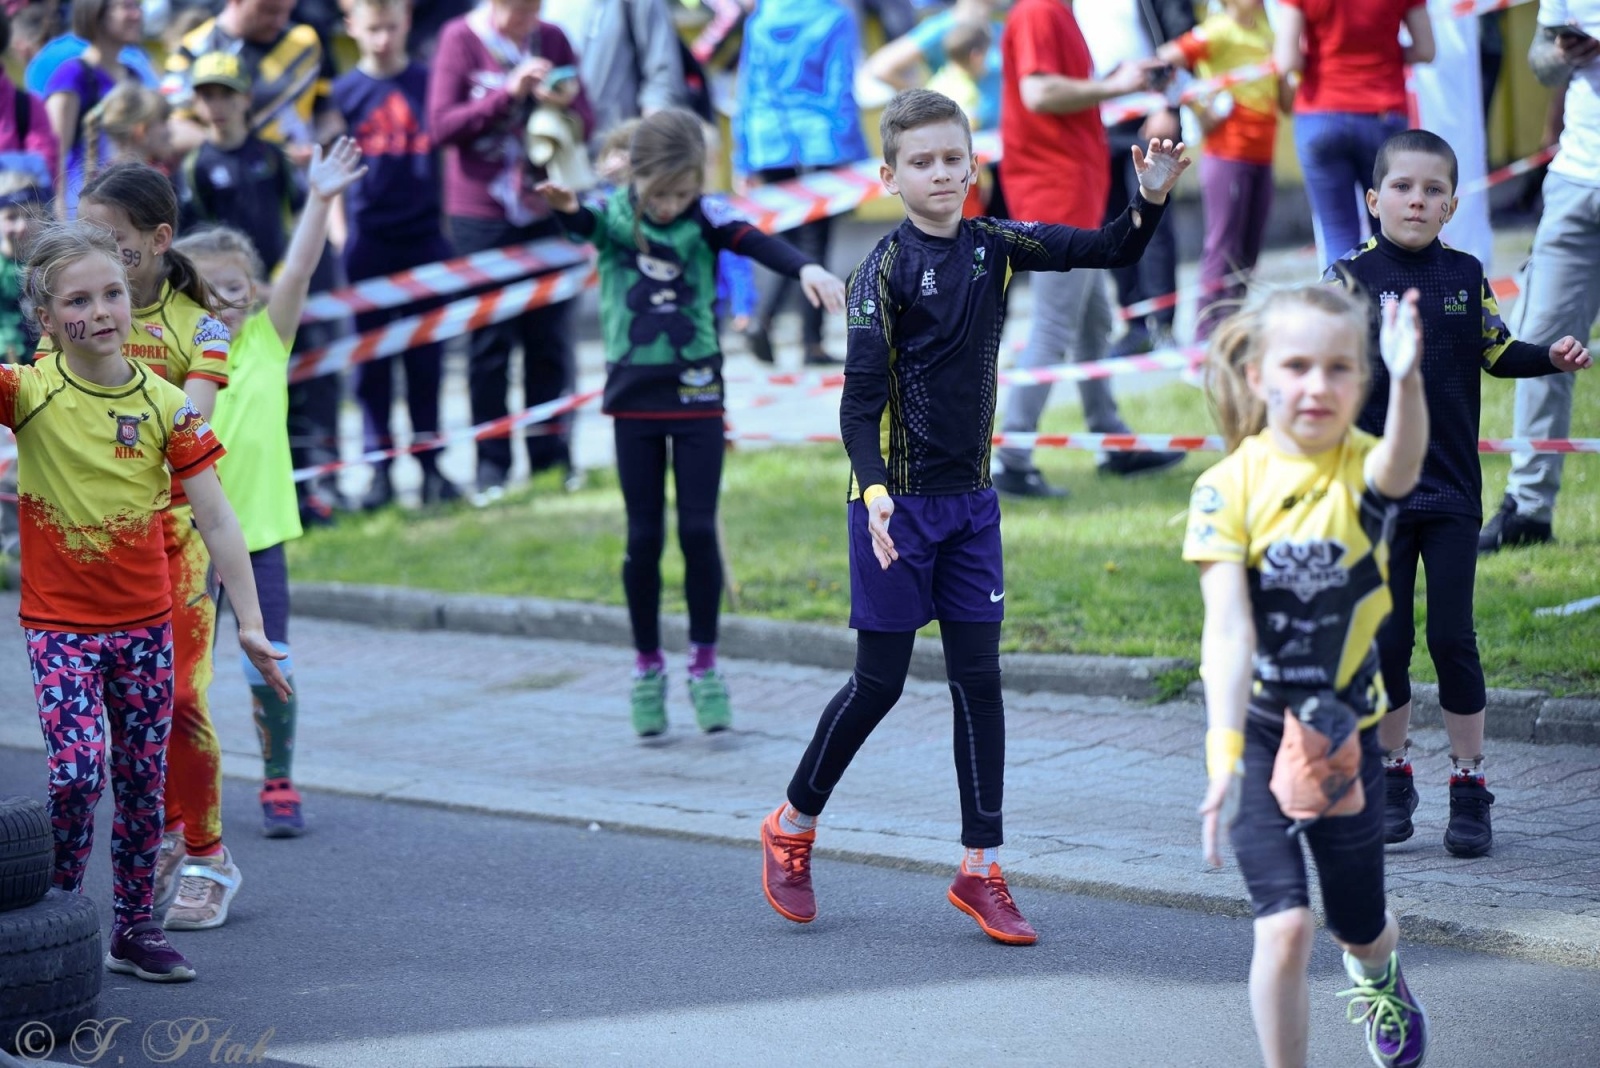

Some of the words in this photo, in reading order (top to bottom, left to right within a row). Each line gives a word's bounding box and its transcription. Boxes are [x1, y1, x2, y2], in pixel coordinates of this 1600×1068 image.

[1444, 304, 1467, 312] MORE
[64, 319, 86, 342] 102
[114, 446, 144, 459] NIKA
